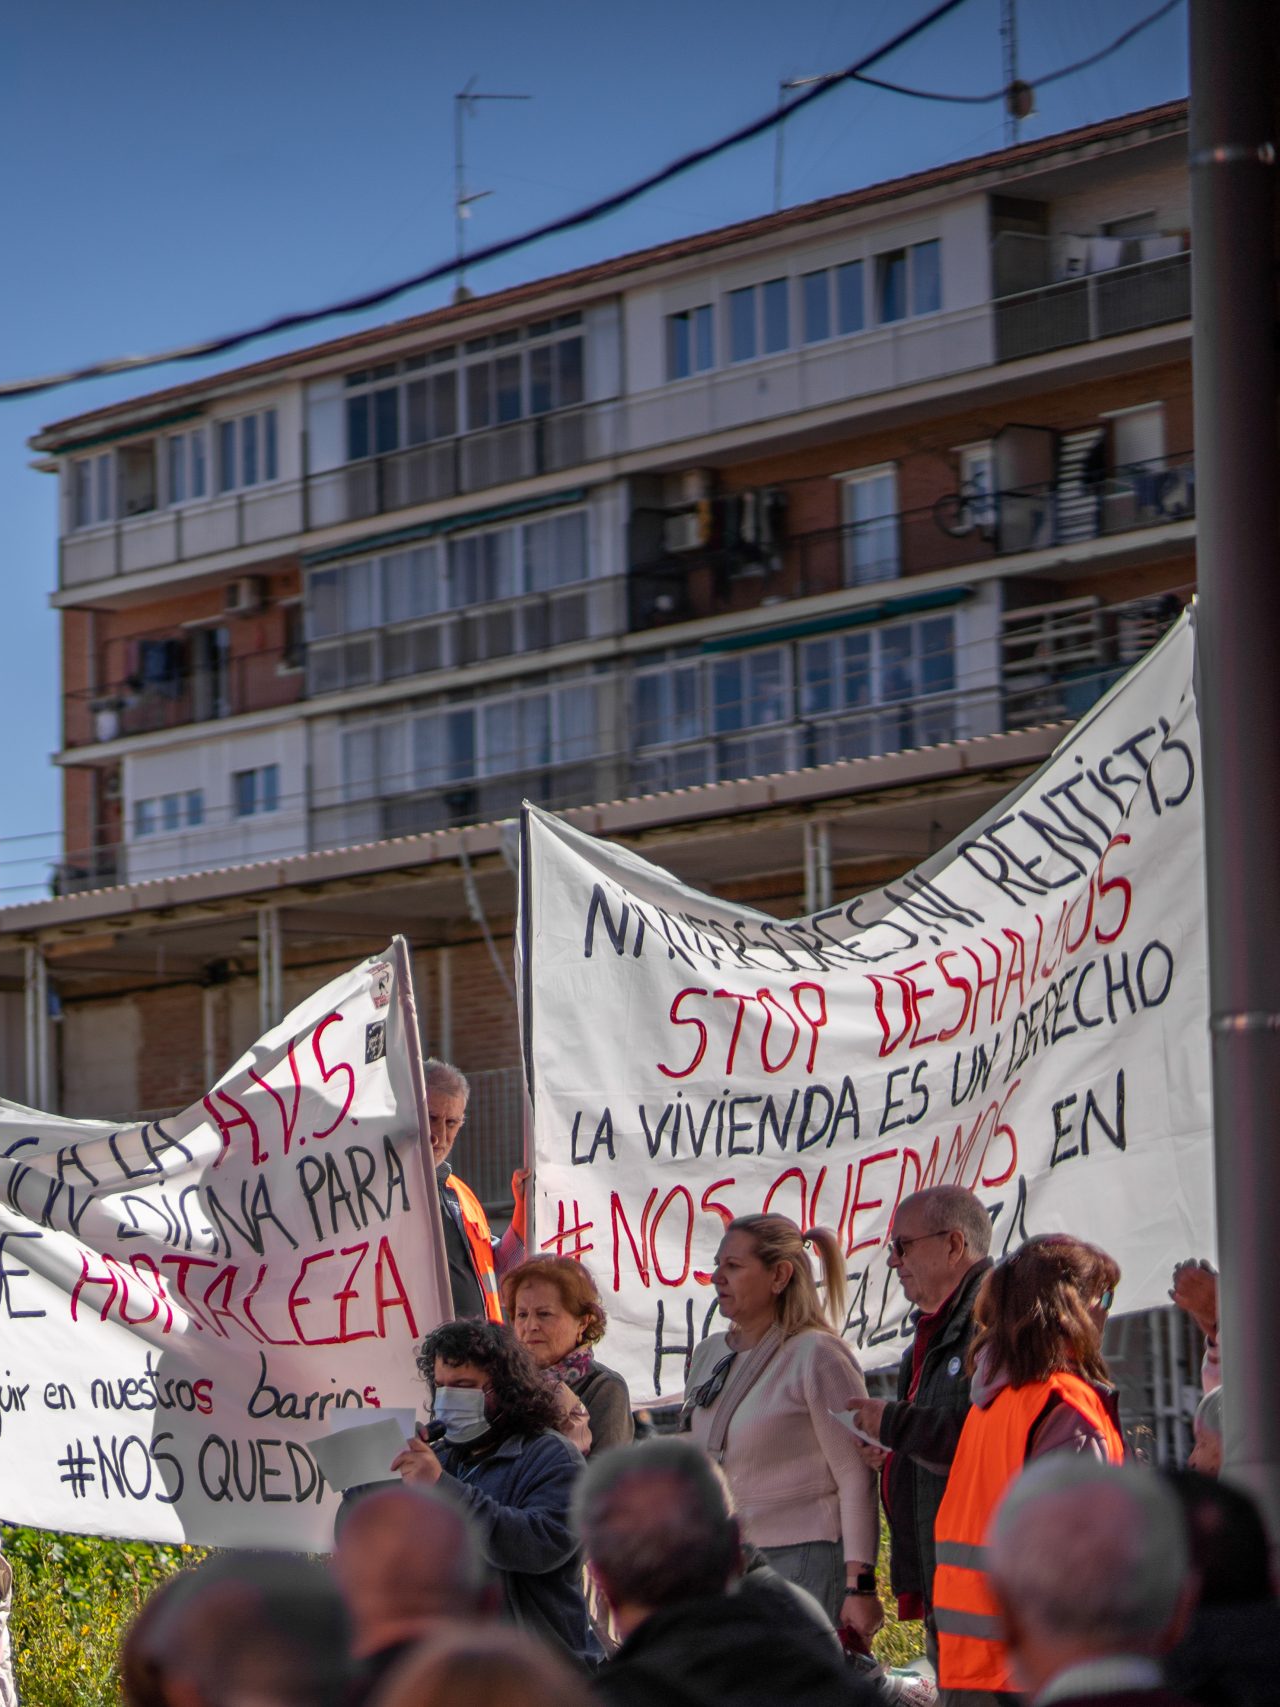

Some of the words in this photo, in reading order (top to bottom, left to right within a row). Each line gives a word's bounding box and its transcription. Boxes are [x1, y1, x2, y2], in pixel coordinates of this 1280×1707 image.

[957, 716, 1195, 907] RENTISTS
[656, 982, 828, 1078] STOP
[572, 1107, 616, 1165] LA
[879, 1060, 929, 1137] ES
[951, 1032, 1001, 1107] UN
[1050, 1068, 1126, 1168] EN
[109, 1121, 193, 1181] LA
[296, 1134, 412, 1243] PARA
[70, 1236, 420, 1346] HORTALEZA
[44, 1382, 76, 1411] en
[91, 1351, 214, 1415] nuestros
[57, 1432, 185, 1504] #NOS
